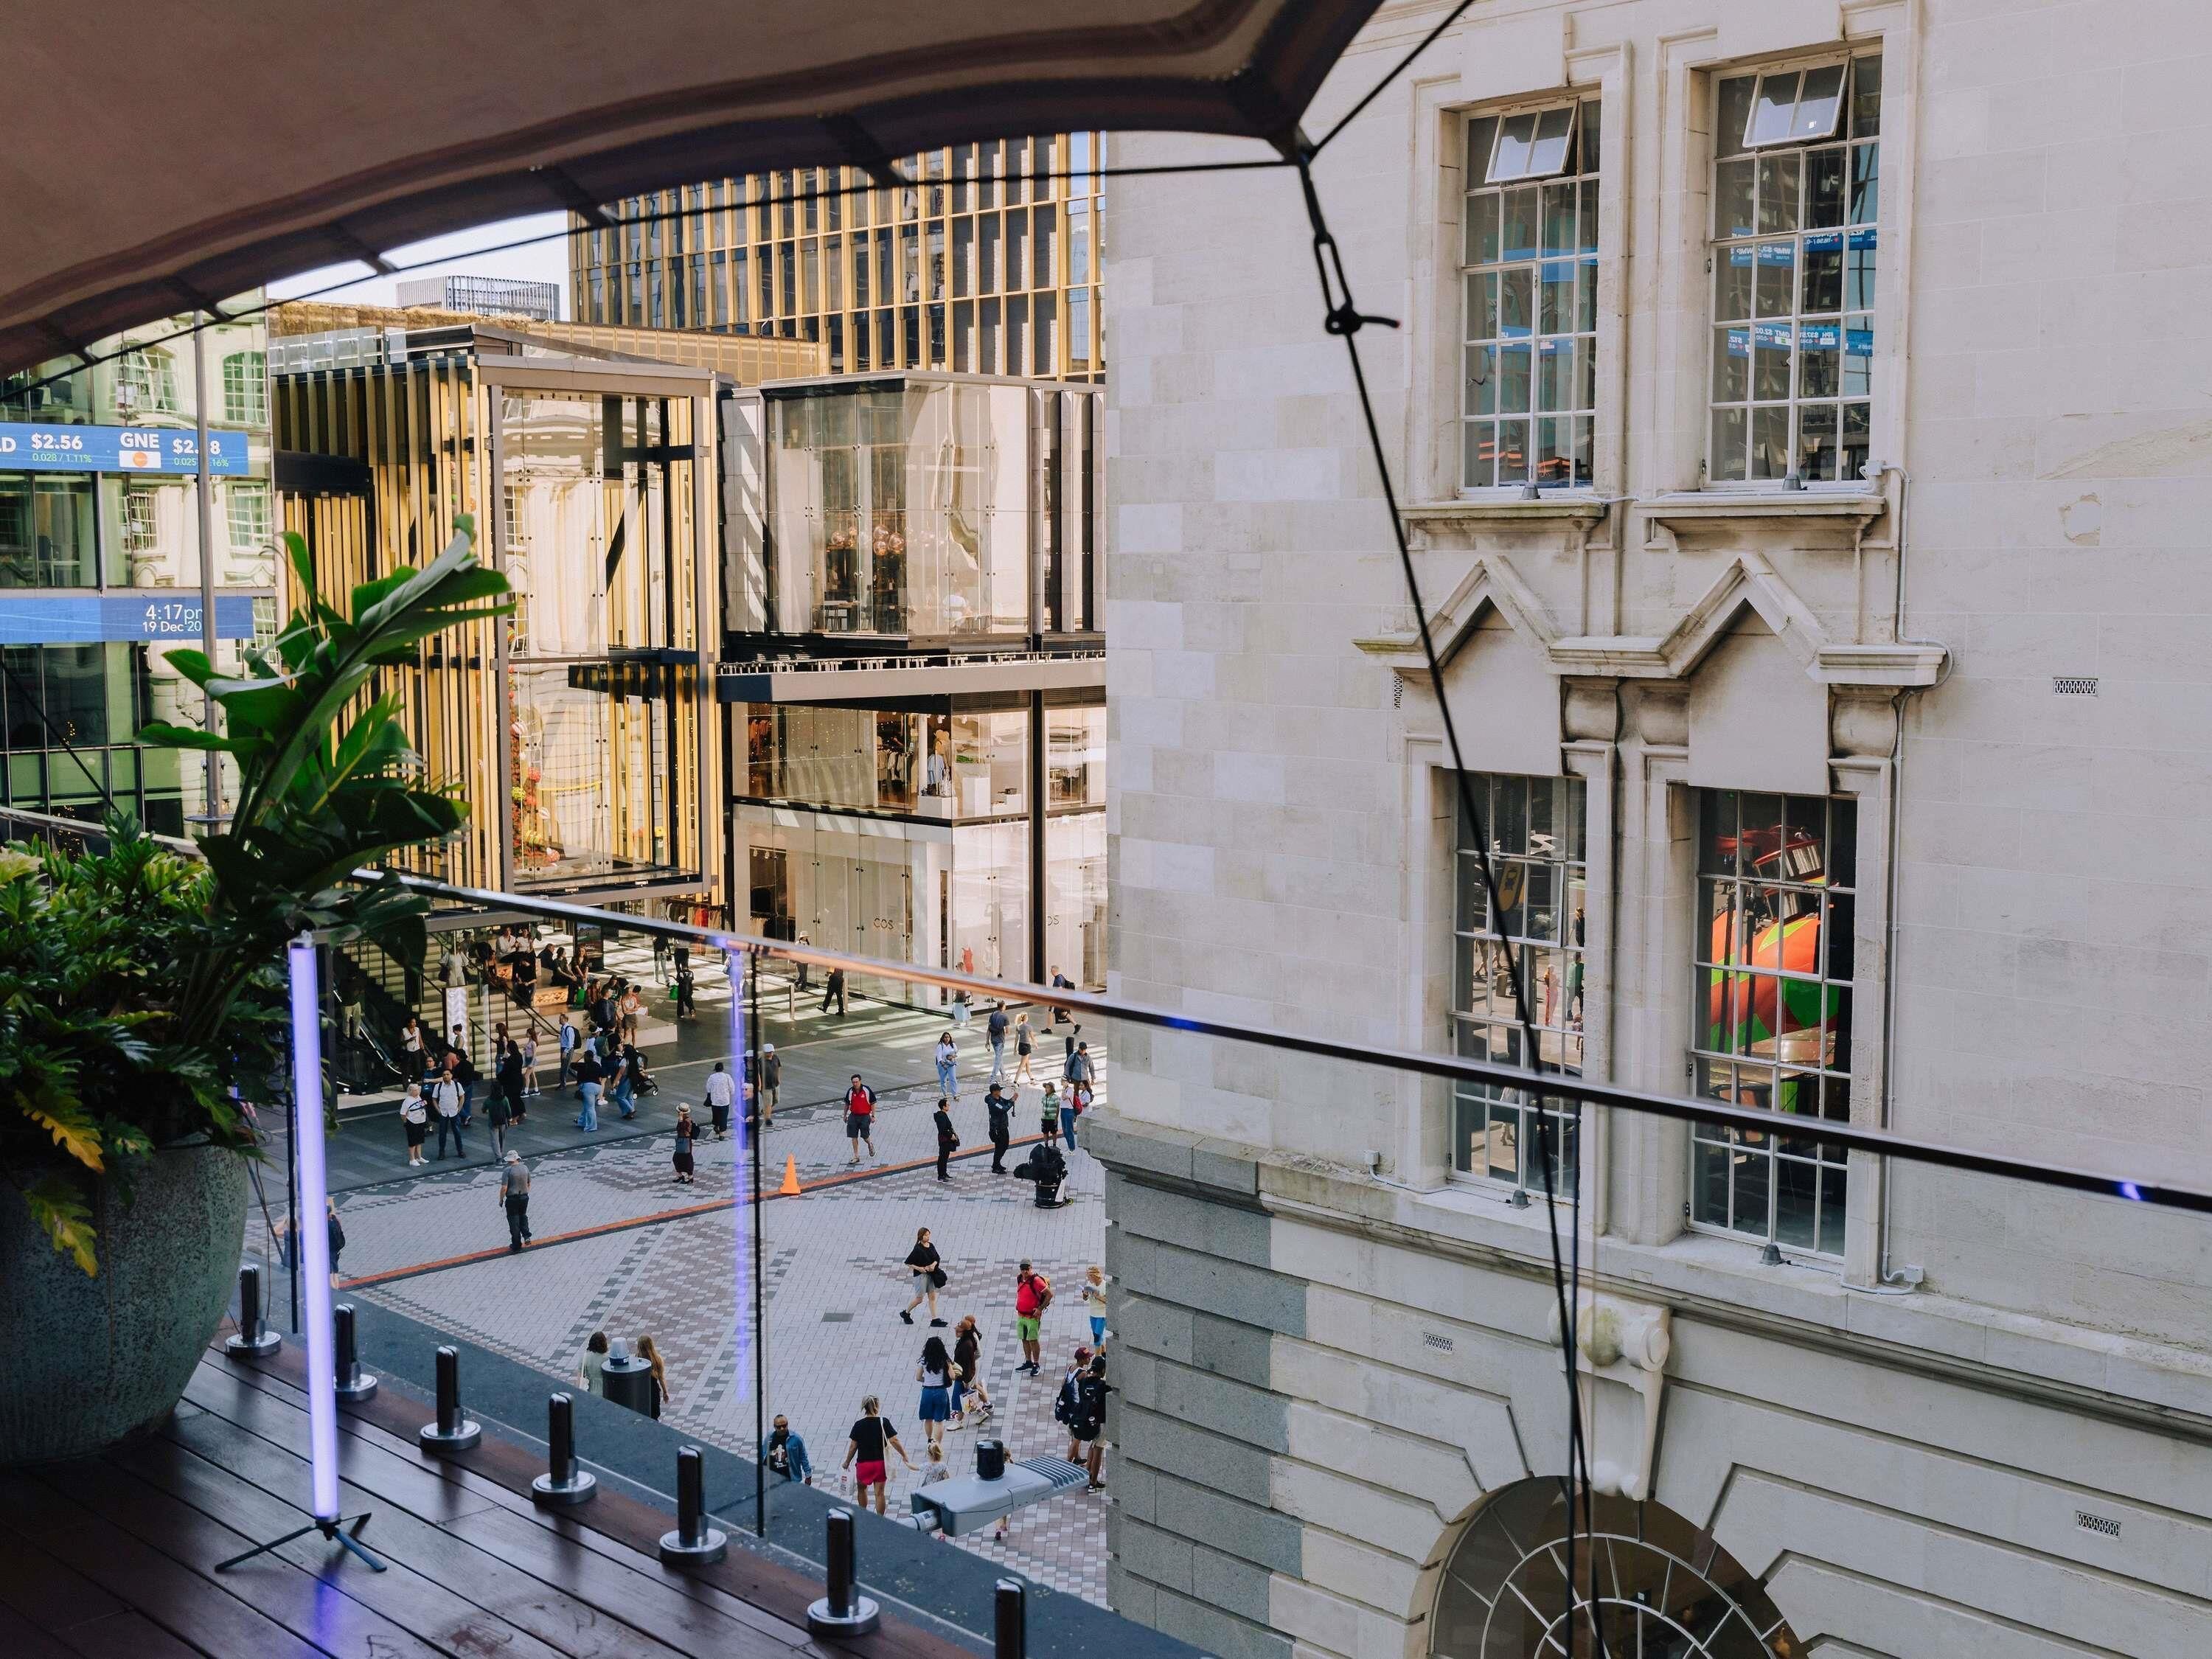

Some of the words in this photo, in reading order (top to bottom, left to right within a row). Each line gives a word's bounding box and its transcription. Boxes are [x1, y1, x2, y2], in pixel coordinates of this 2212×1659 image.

[0, 437, 17, 453] D
[31, 432, 83, 450] $2.56
[119, 432, 160, 449] GNE
[172, 438, 220, 455] $2.8
[142, 621, 157, 632] 19
[161, 621, 184, 632] Dec
[873, 917, 894, 930] COS
